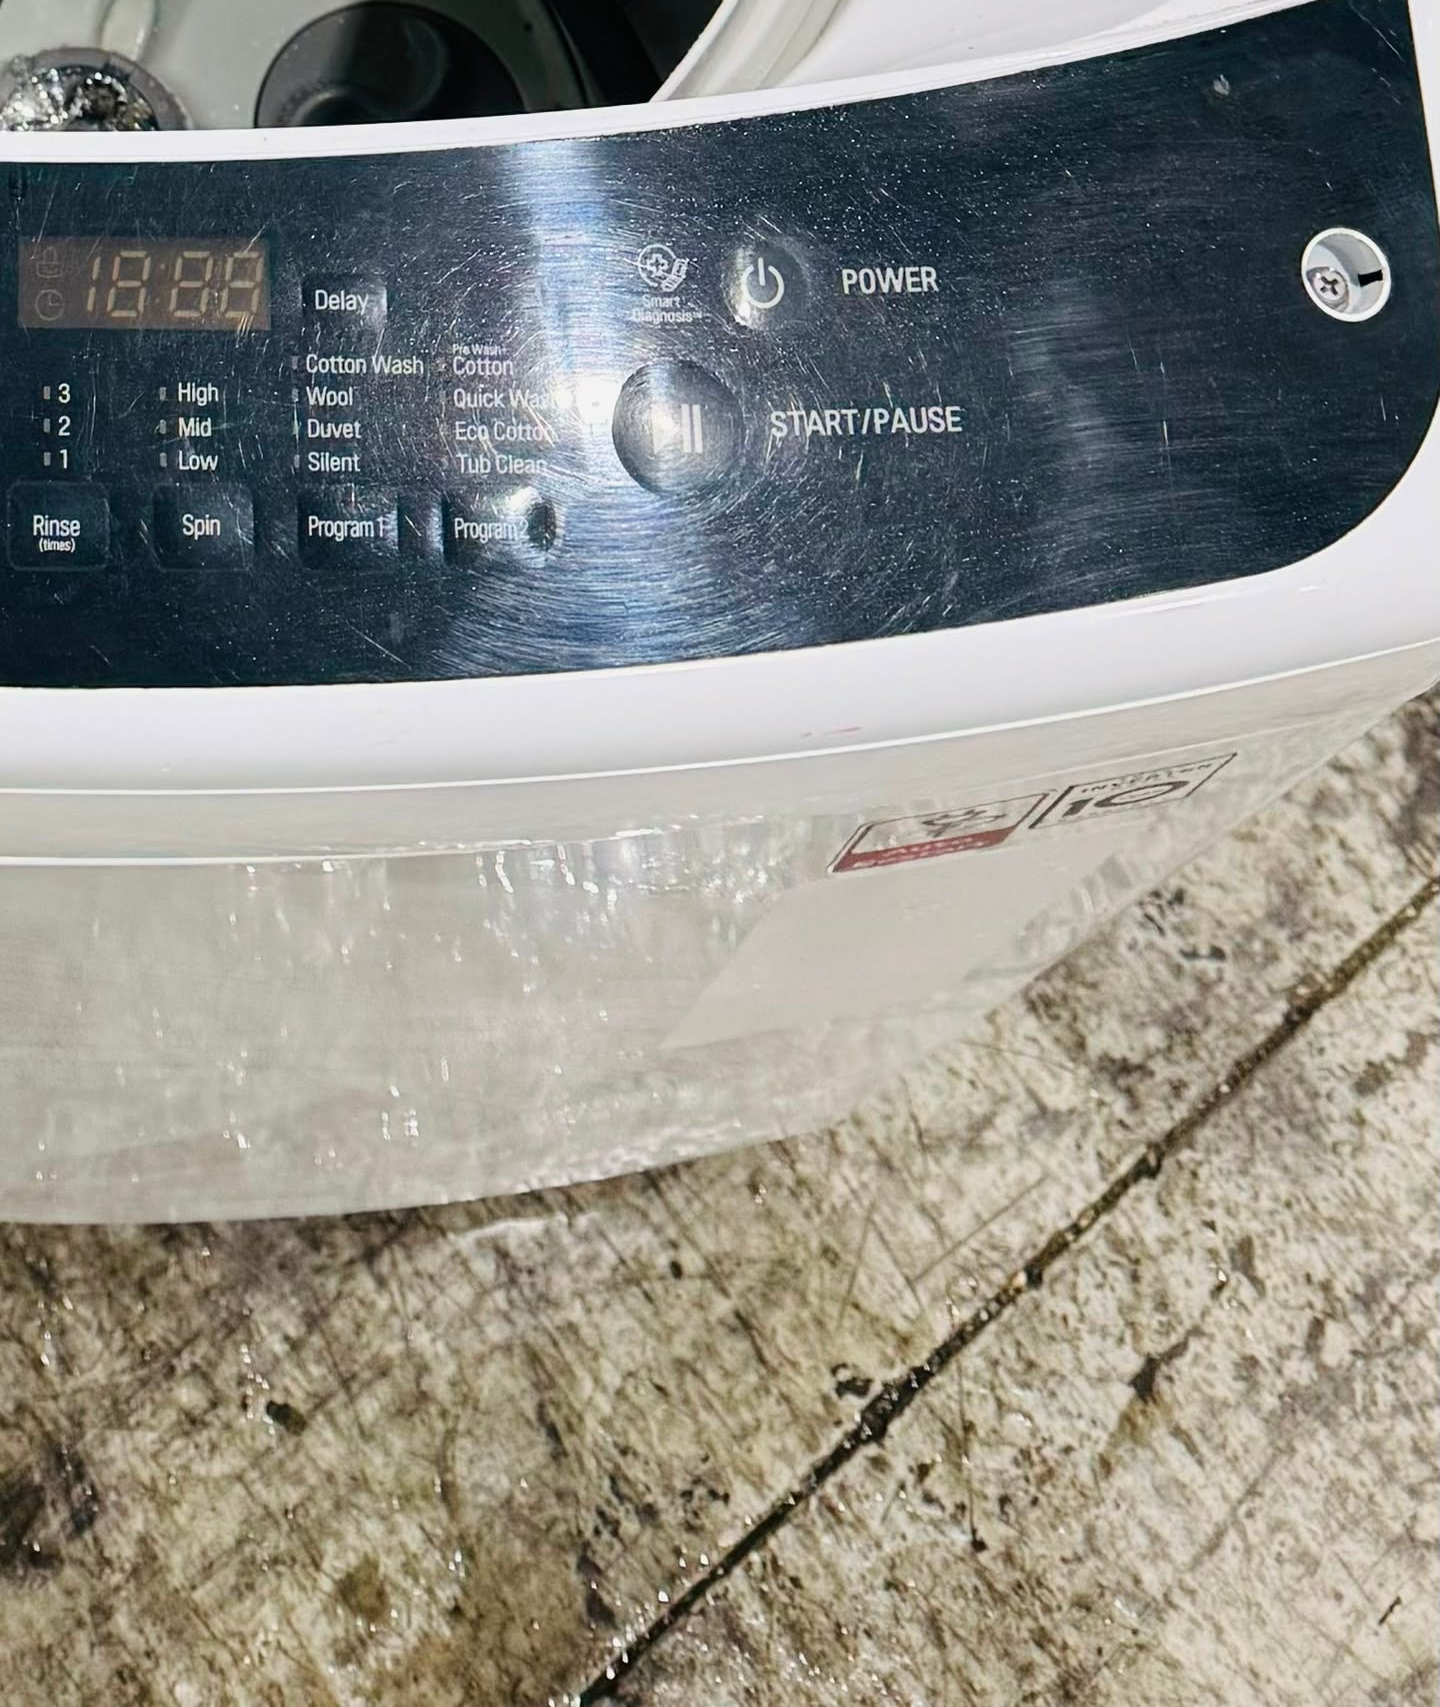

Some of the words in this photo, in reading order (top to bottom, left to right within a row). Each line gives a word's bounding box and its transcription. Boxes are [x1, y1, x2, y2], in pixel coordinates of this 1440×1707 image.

[842, 266, 938, 295] POWER
[314, 289, 369, 314] Delay
[642, 295, 681, 308] Smart
[306, 353, 367, 375] Cotton
[372, 354, 425, 375] Wash
[453, 356, 514, 377] Cotton
[58, 383, 71, 404] 3
[177, 382, 220, 406] High
[306, 386, 354, 406] Wool
[453, 388, 505, 409] Quick
[509, 389, 552, 409] Was
[58, 416, 71, 436] 2
[178, 416, 212, 437] Mid
[307, 418, 361, 439] Duvet
[454, 422, 488, 442] Eco
[494, 421, 557, 442] Cotton
[771, 405, 963, 438] START/PAUSE
[59, 449, 69, 469] 1
[178, 451, 218, 472] Low
[307, 451, 361, 472] Silent
[457, 454, 491, 474] Tub
[495, 455, 548, 474] Clean
[32, 515, 81, 537] Rinse
[182, 513, 222, 540] Spin
[308, 517, 375, 542] Program
[377, 518, 385, 538] 1
[454, 518, 517, 543] Program
[517, 520, 530, 539] 2
[38, 537, 76, 554] (times)
[1062, 780, 1190, 818] 10
